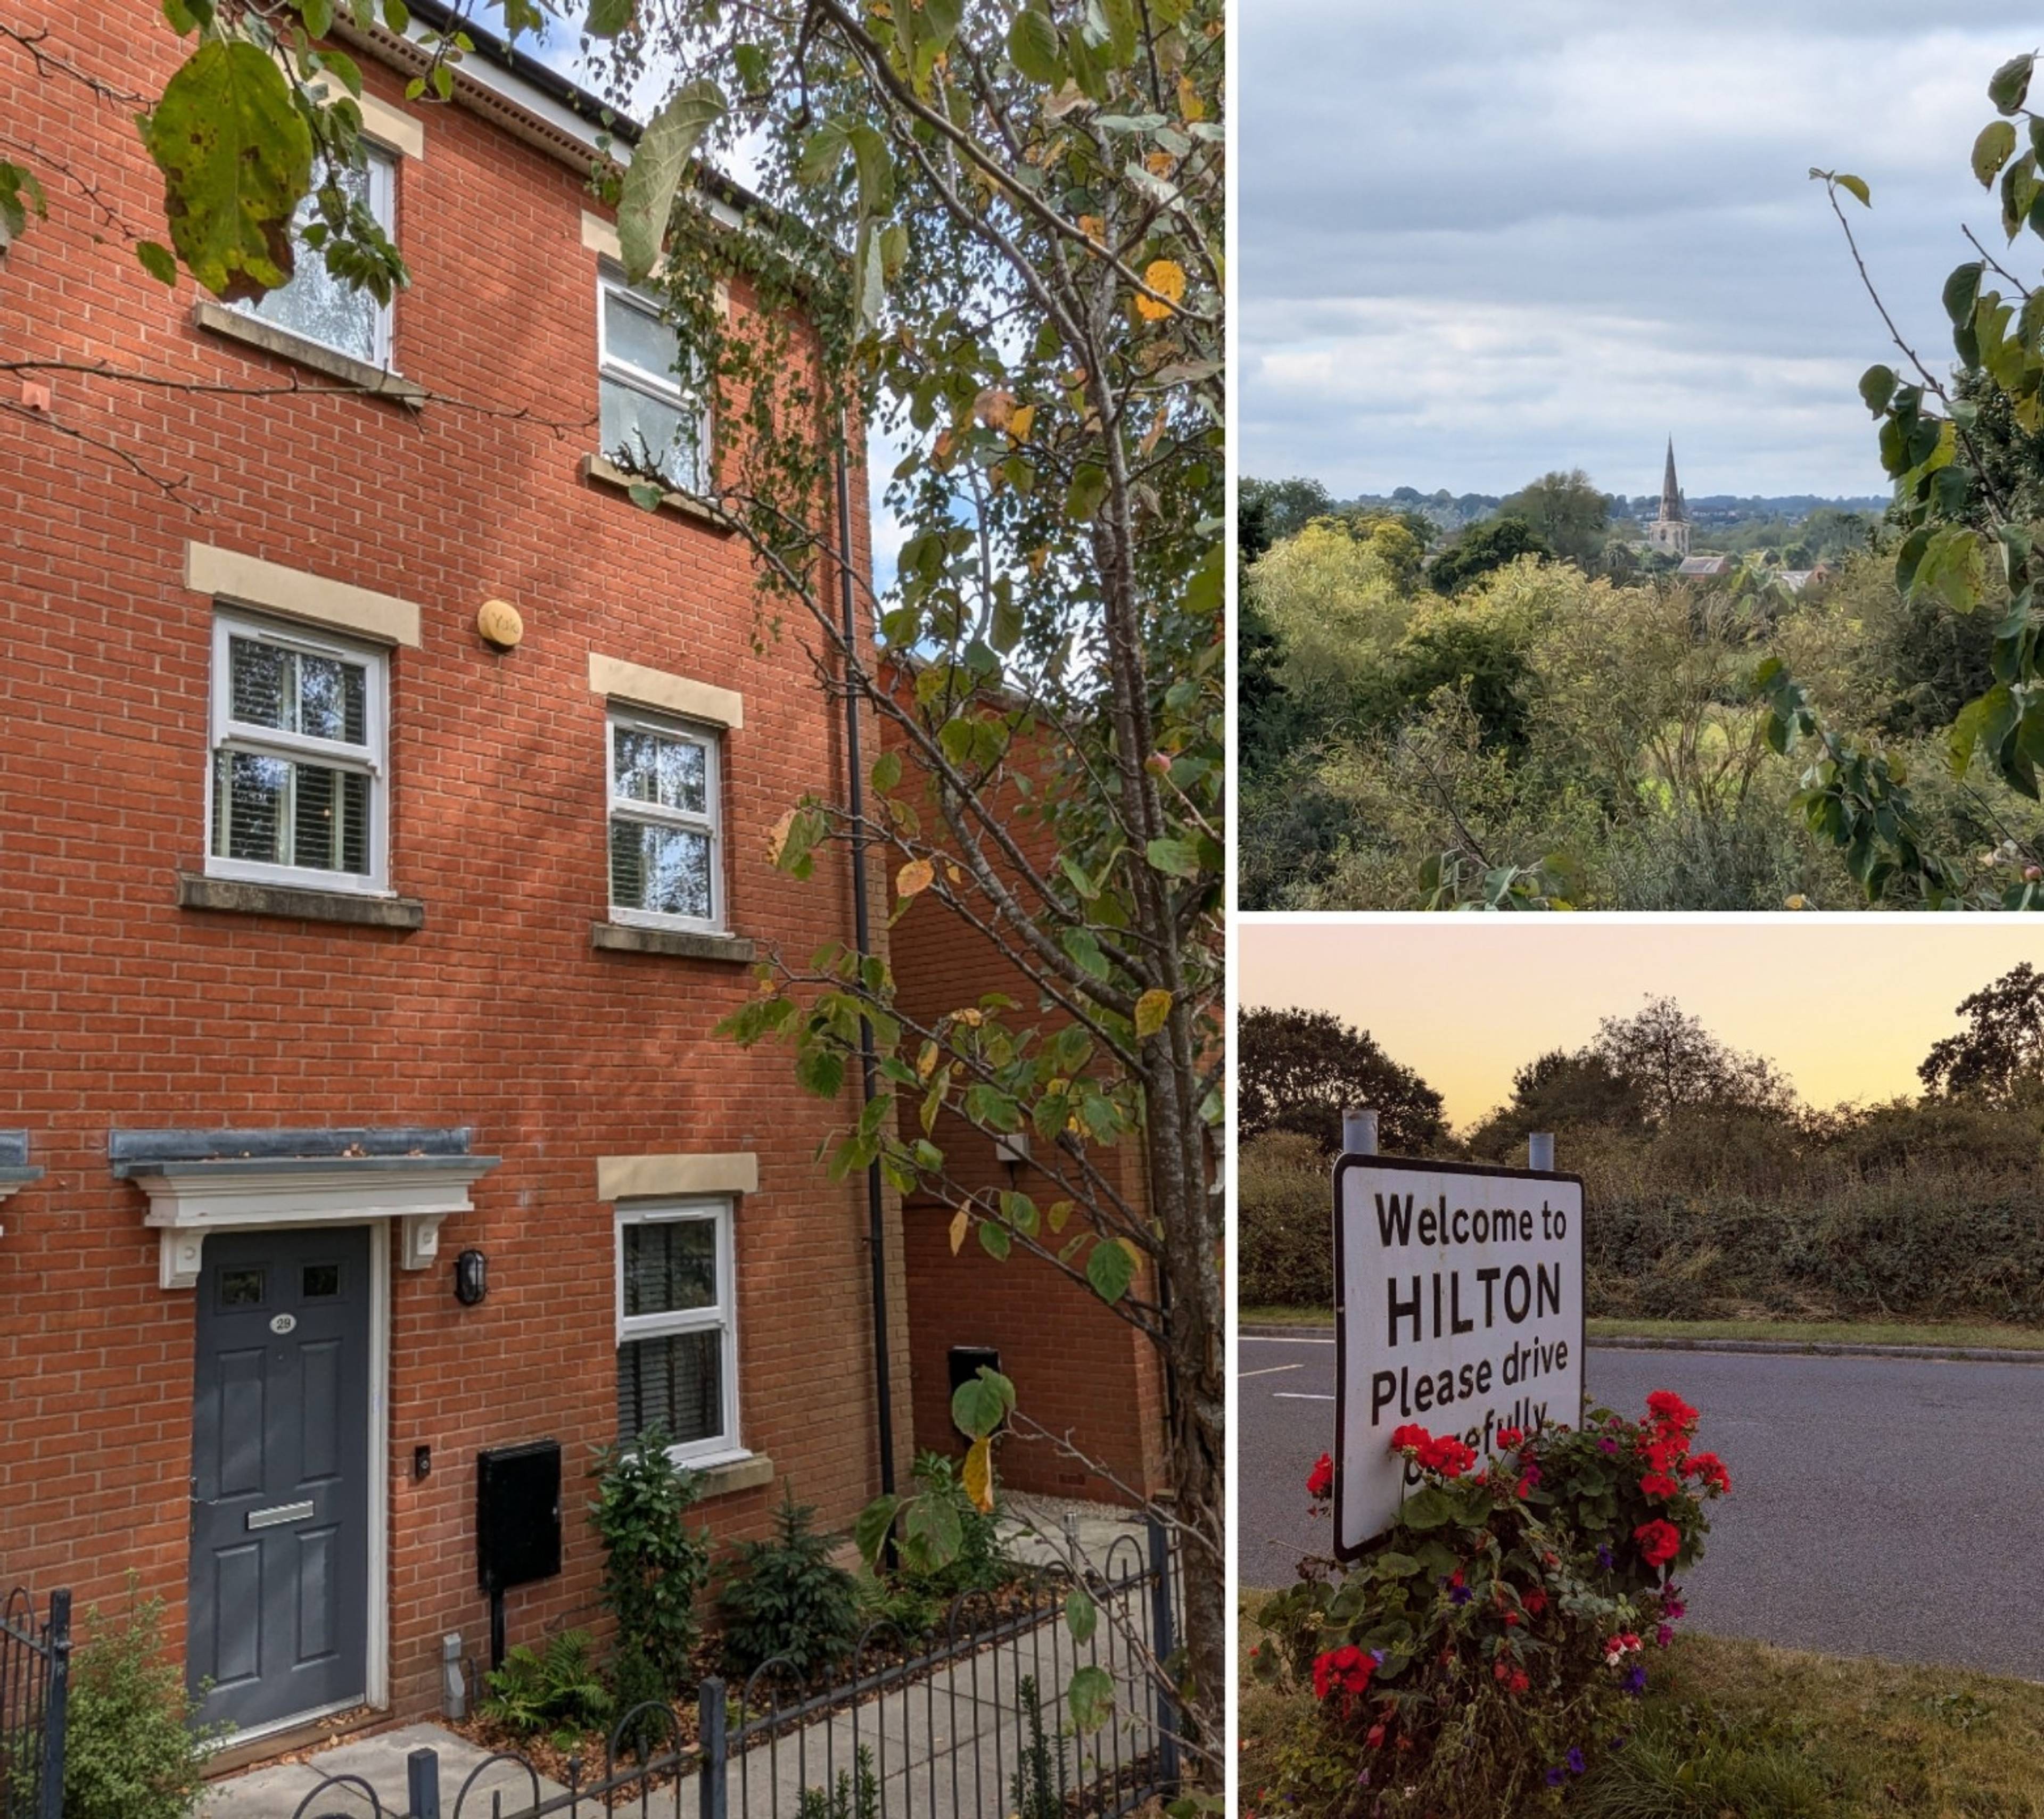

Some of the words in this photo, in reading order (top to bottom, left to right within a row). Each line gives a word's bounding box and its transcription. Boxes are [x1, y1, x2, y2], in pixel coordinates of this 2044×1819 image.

[1375, 1193, 1532, 1247] Welcome
[1542, 1200, 1567, 1241] to
[1388, 1262, 1560, 1347] HILTON
[1372, 1360, 1492, 1426] Please
[1503, 1336, 1568, 1385] drive
